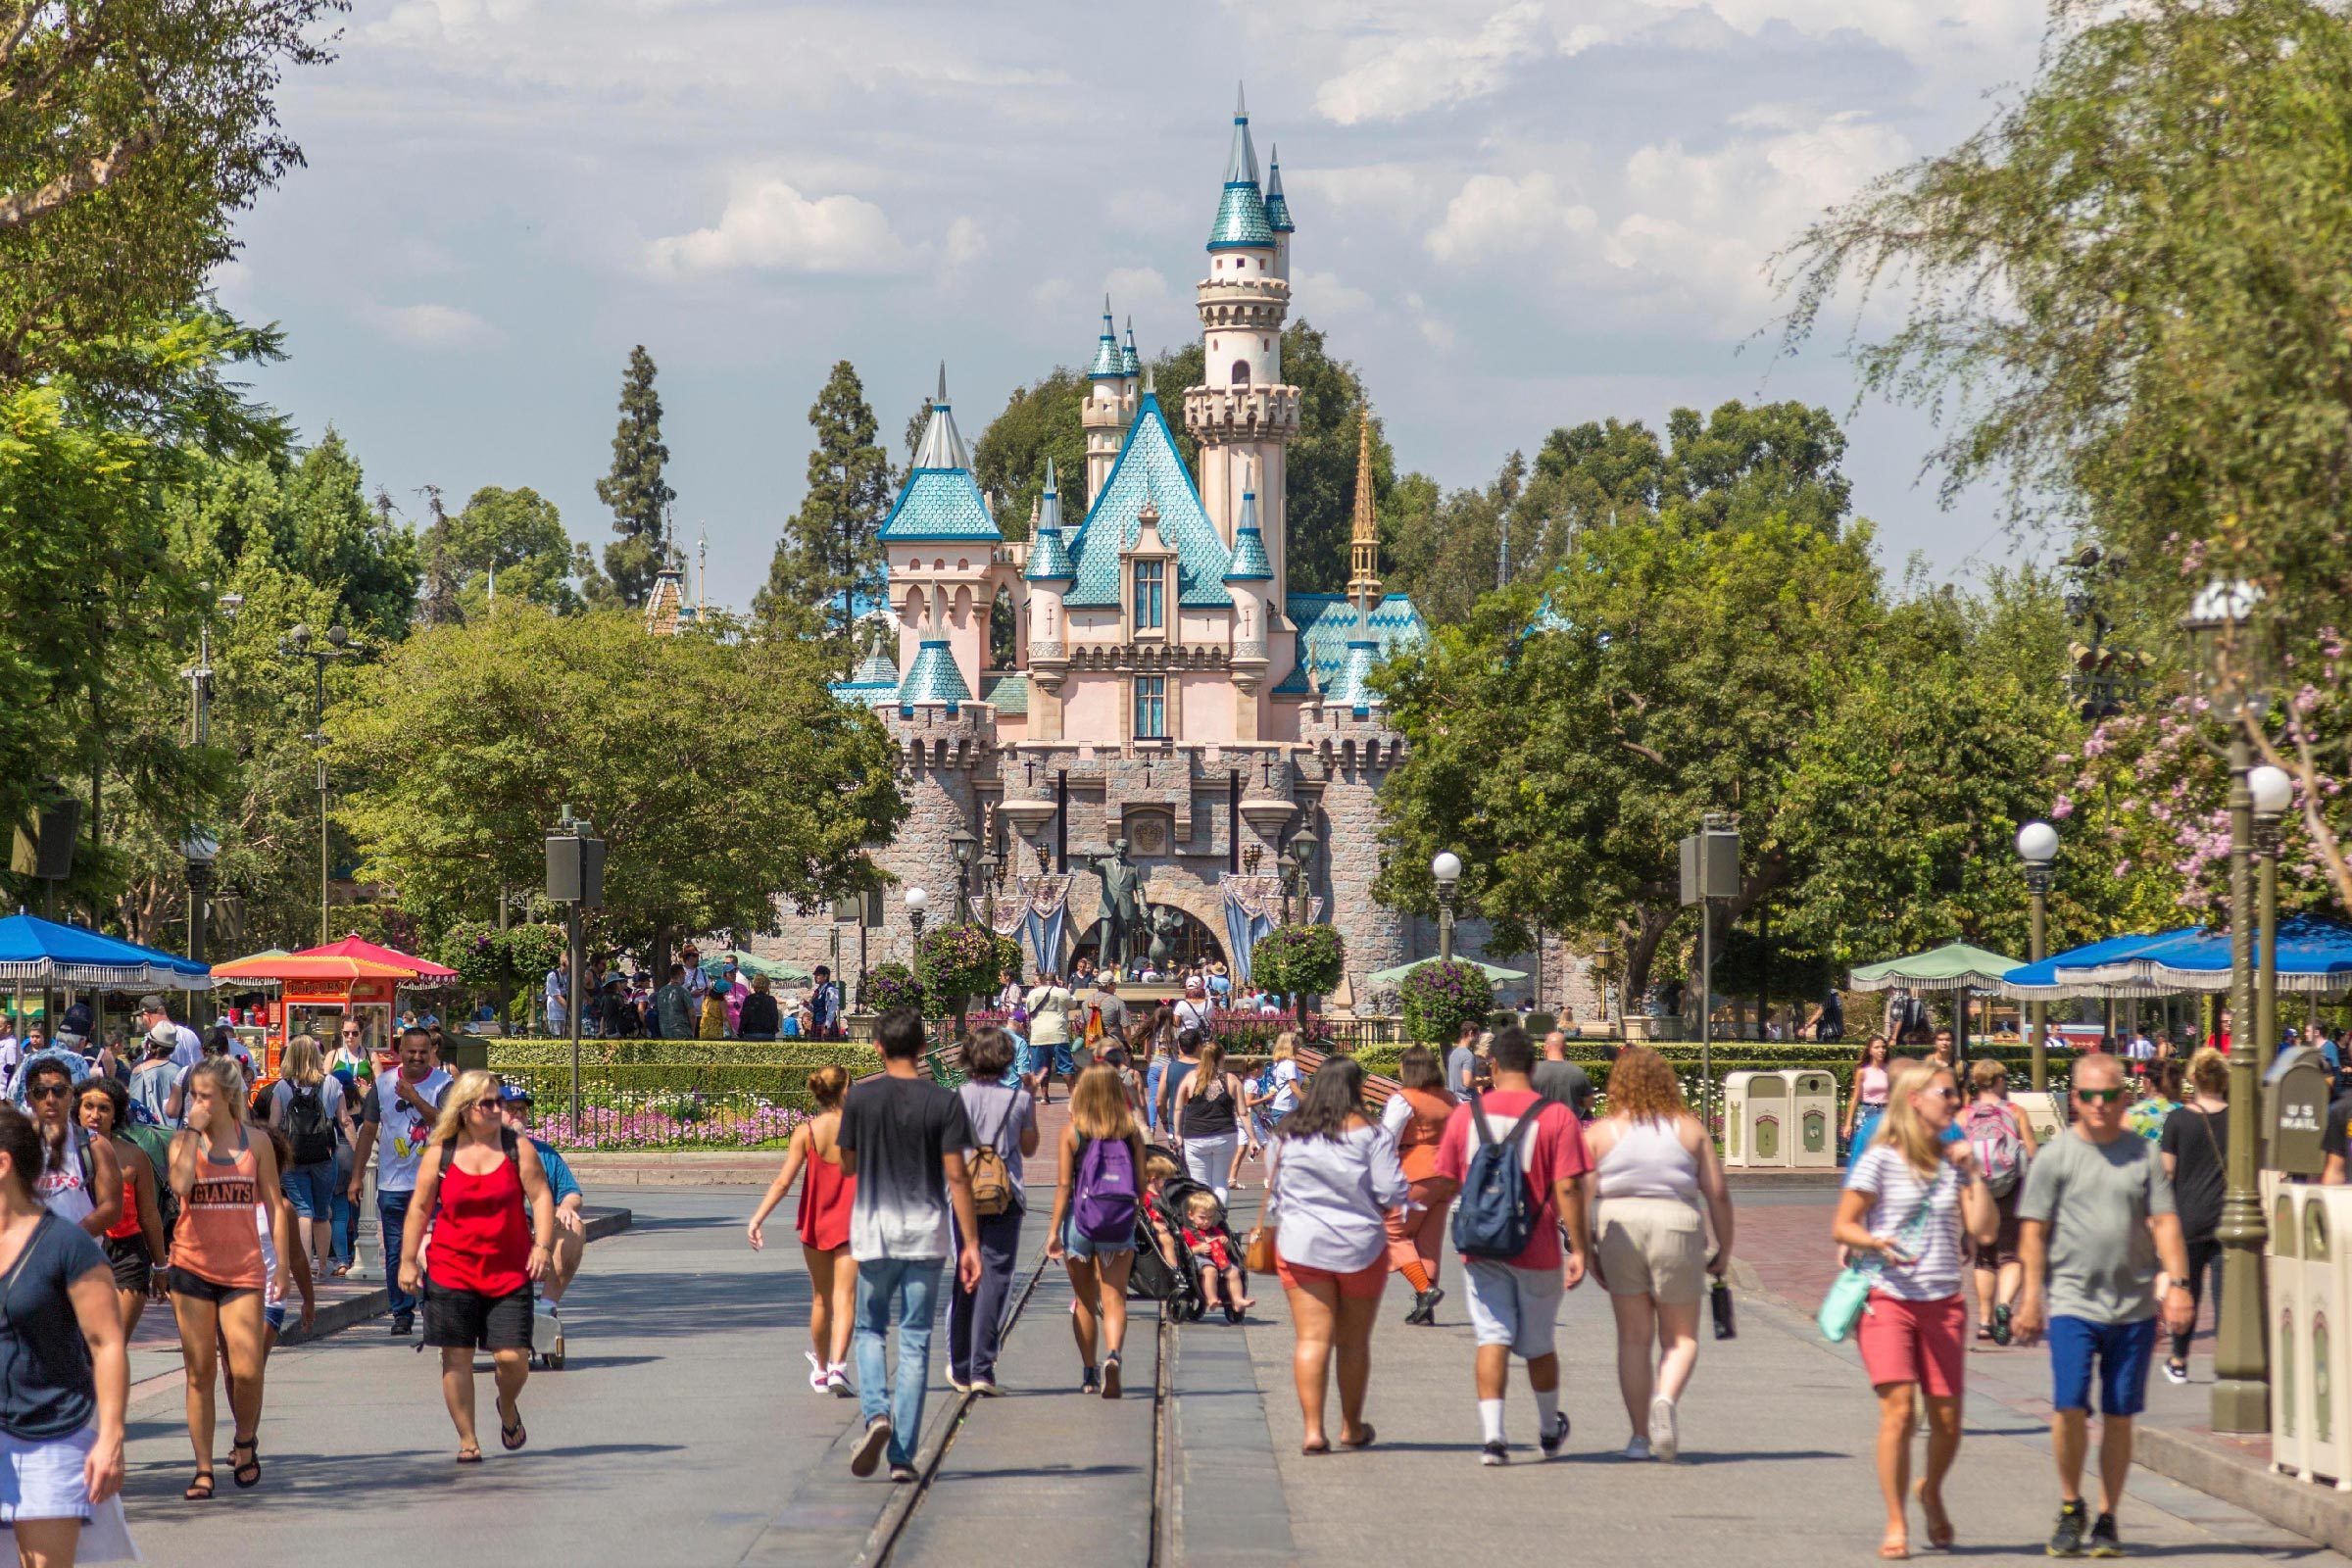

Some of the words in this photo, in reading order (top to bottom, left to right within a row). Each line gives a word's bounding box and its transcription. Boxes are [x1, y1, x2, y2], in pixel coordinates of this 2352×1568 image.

[291, 982, 341, 994] POPCORN
[2280, 1117, 2320, 1131] MAIL
[194, 1183, 252, 1202] GIANTS
